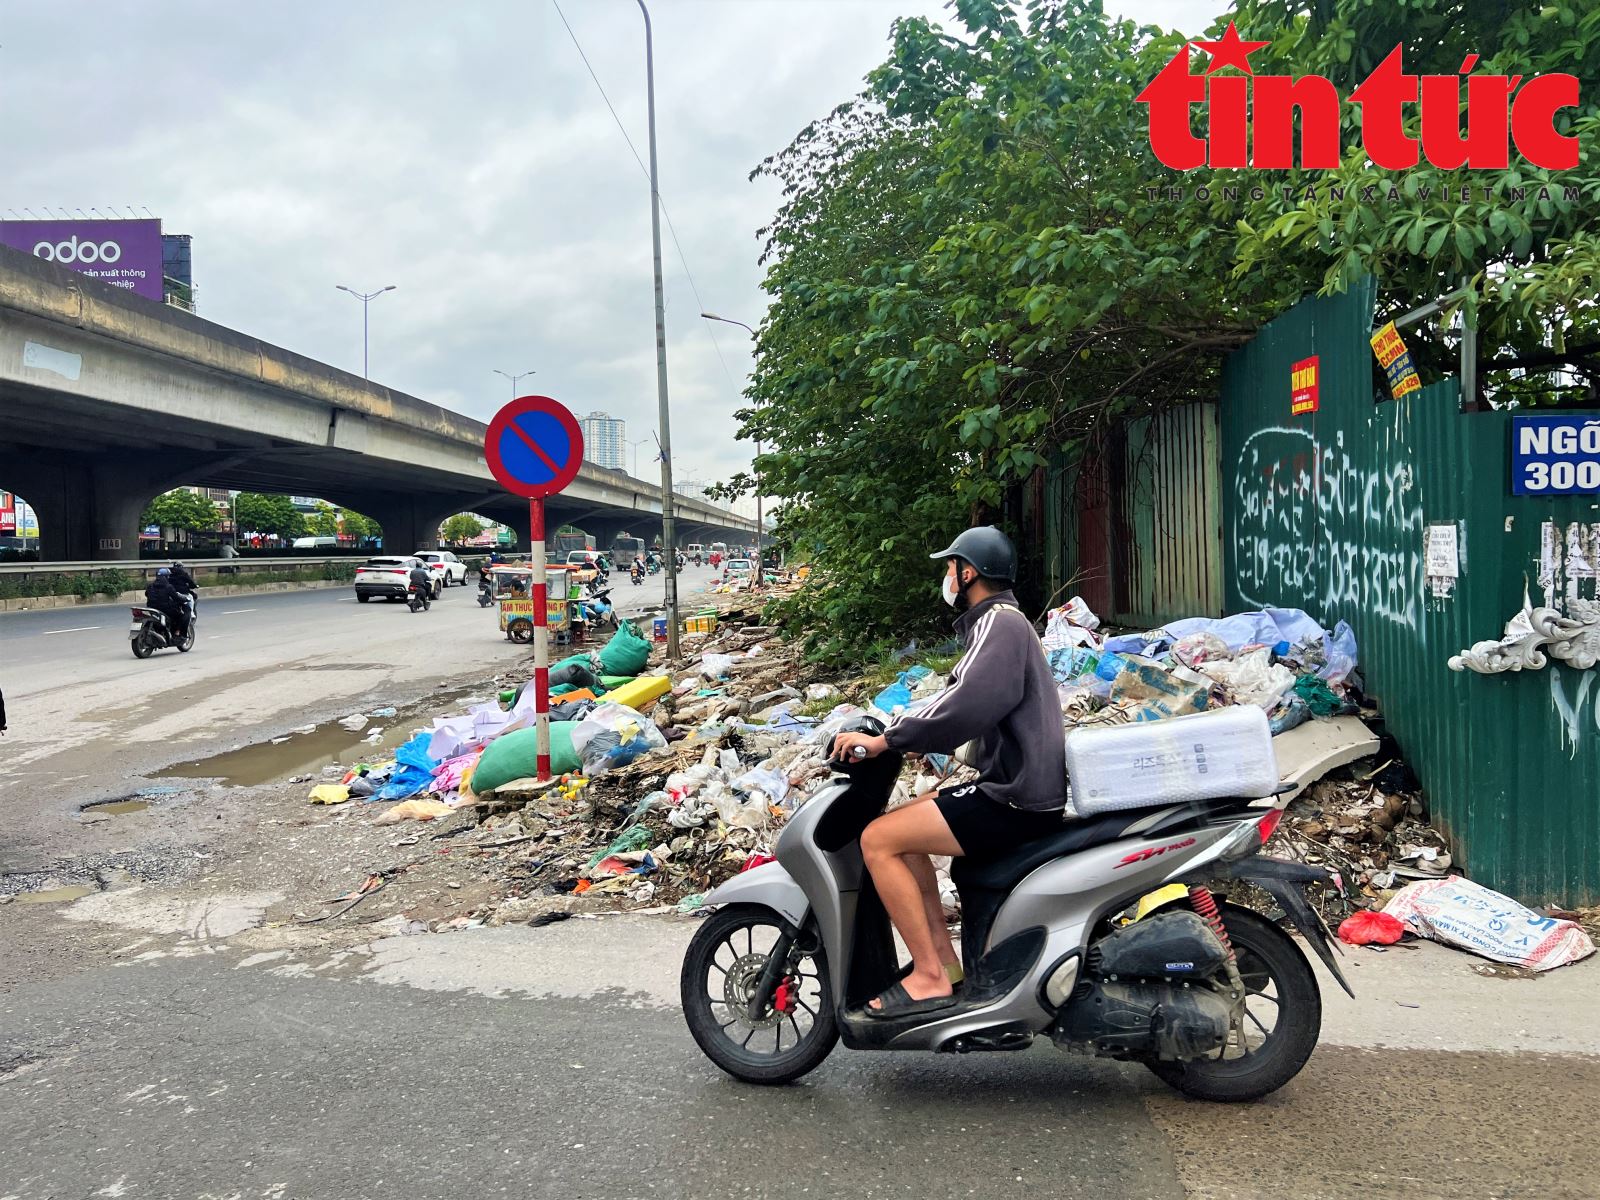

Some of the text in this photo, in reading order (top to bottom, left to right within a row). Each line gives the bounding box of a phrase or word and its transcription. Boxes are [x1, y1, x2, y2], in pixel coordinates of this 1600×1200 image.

[33, 235, 121, 263] odoo
[100, 269, 119, 277] xuất
[121, 269, 146, 279] thông
[1520, 420, 1600, 454] NGÕ
[1524, 461, 1600, 490] 300
